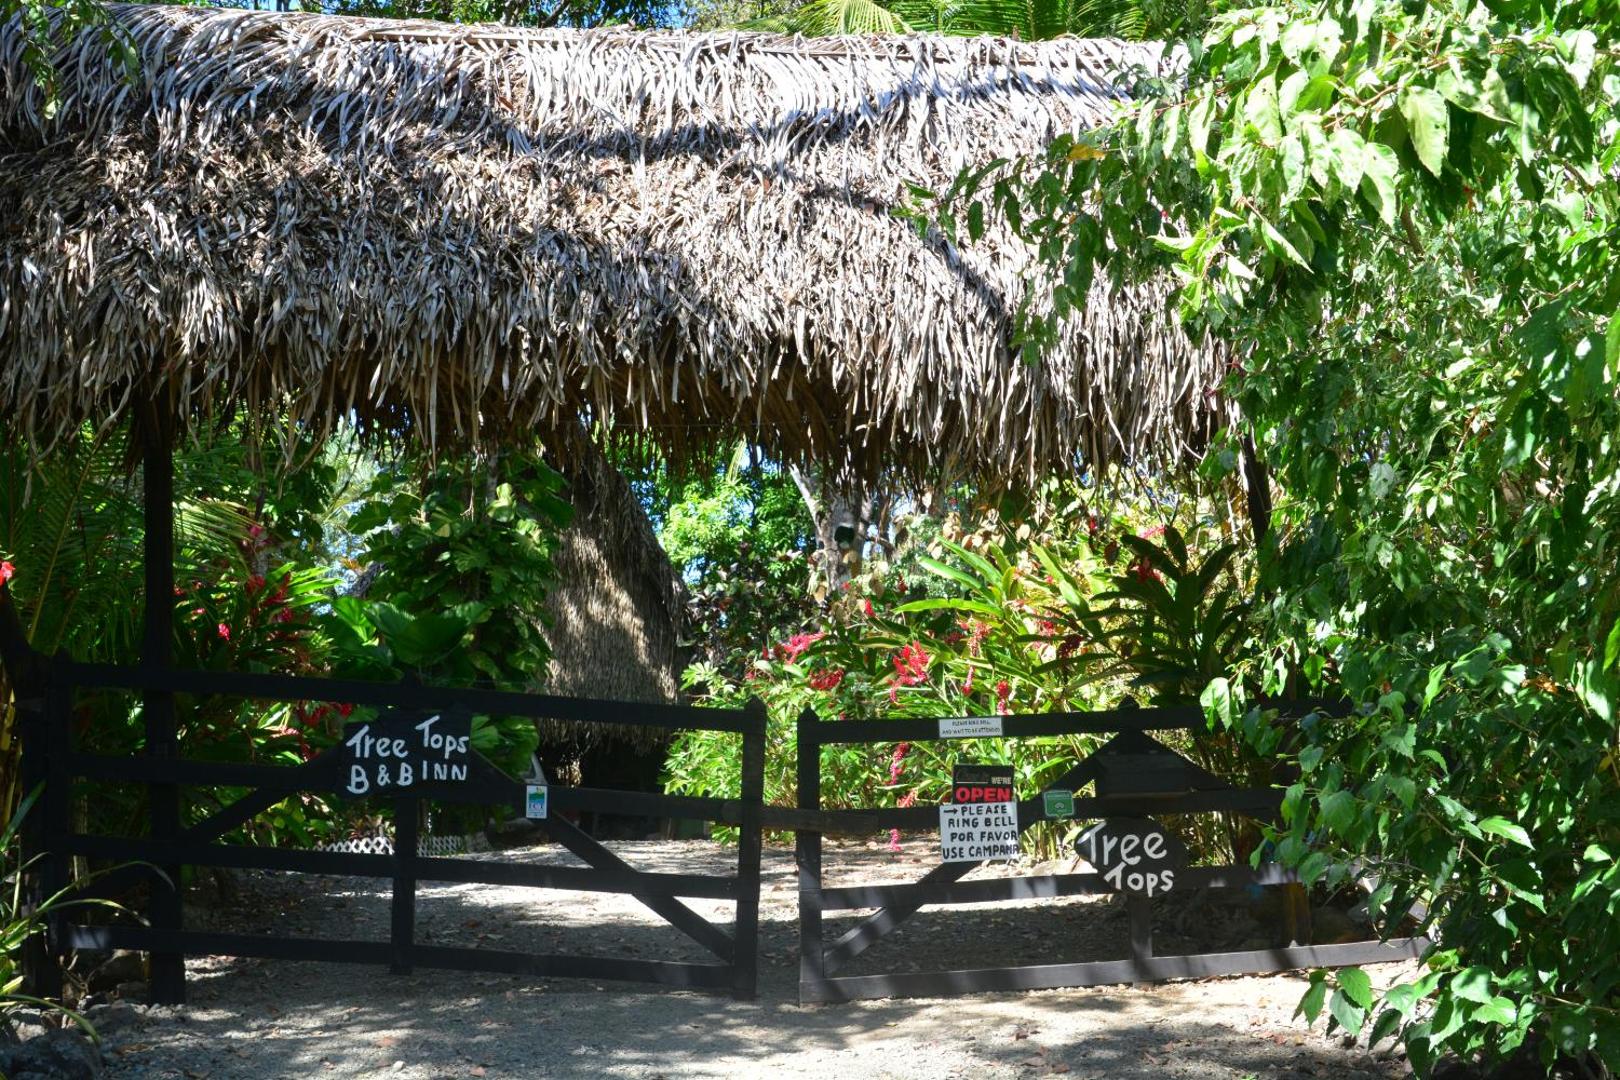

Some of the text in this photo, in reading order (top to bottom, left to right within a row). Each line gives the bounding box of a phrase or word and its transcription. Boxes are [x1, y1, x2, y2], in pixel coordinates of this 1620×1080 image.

[346, 714, 469, 759] Tree Tops
[422, 760, 467, 780] INN
[955, 786, 1011, 802] OPEN
[961, 804, 1007, 816] PLEASE
[948, 816, 1016, 828] RING BELL
[950, 830, 1018, 842] POR FAVOR
[1077, 821, 1167, 866] Tree
[942, 844, 1020, 860] USE CAMPANA
[1103, 861, 1175, 898] Tops
